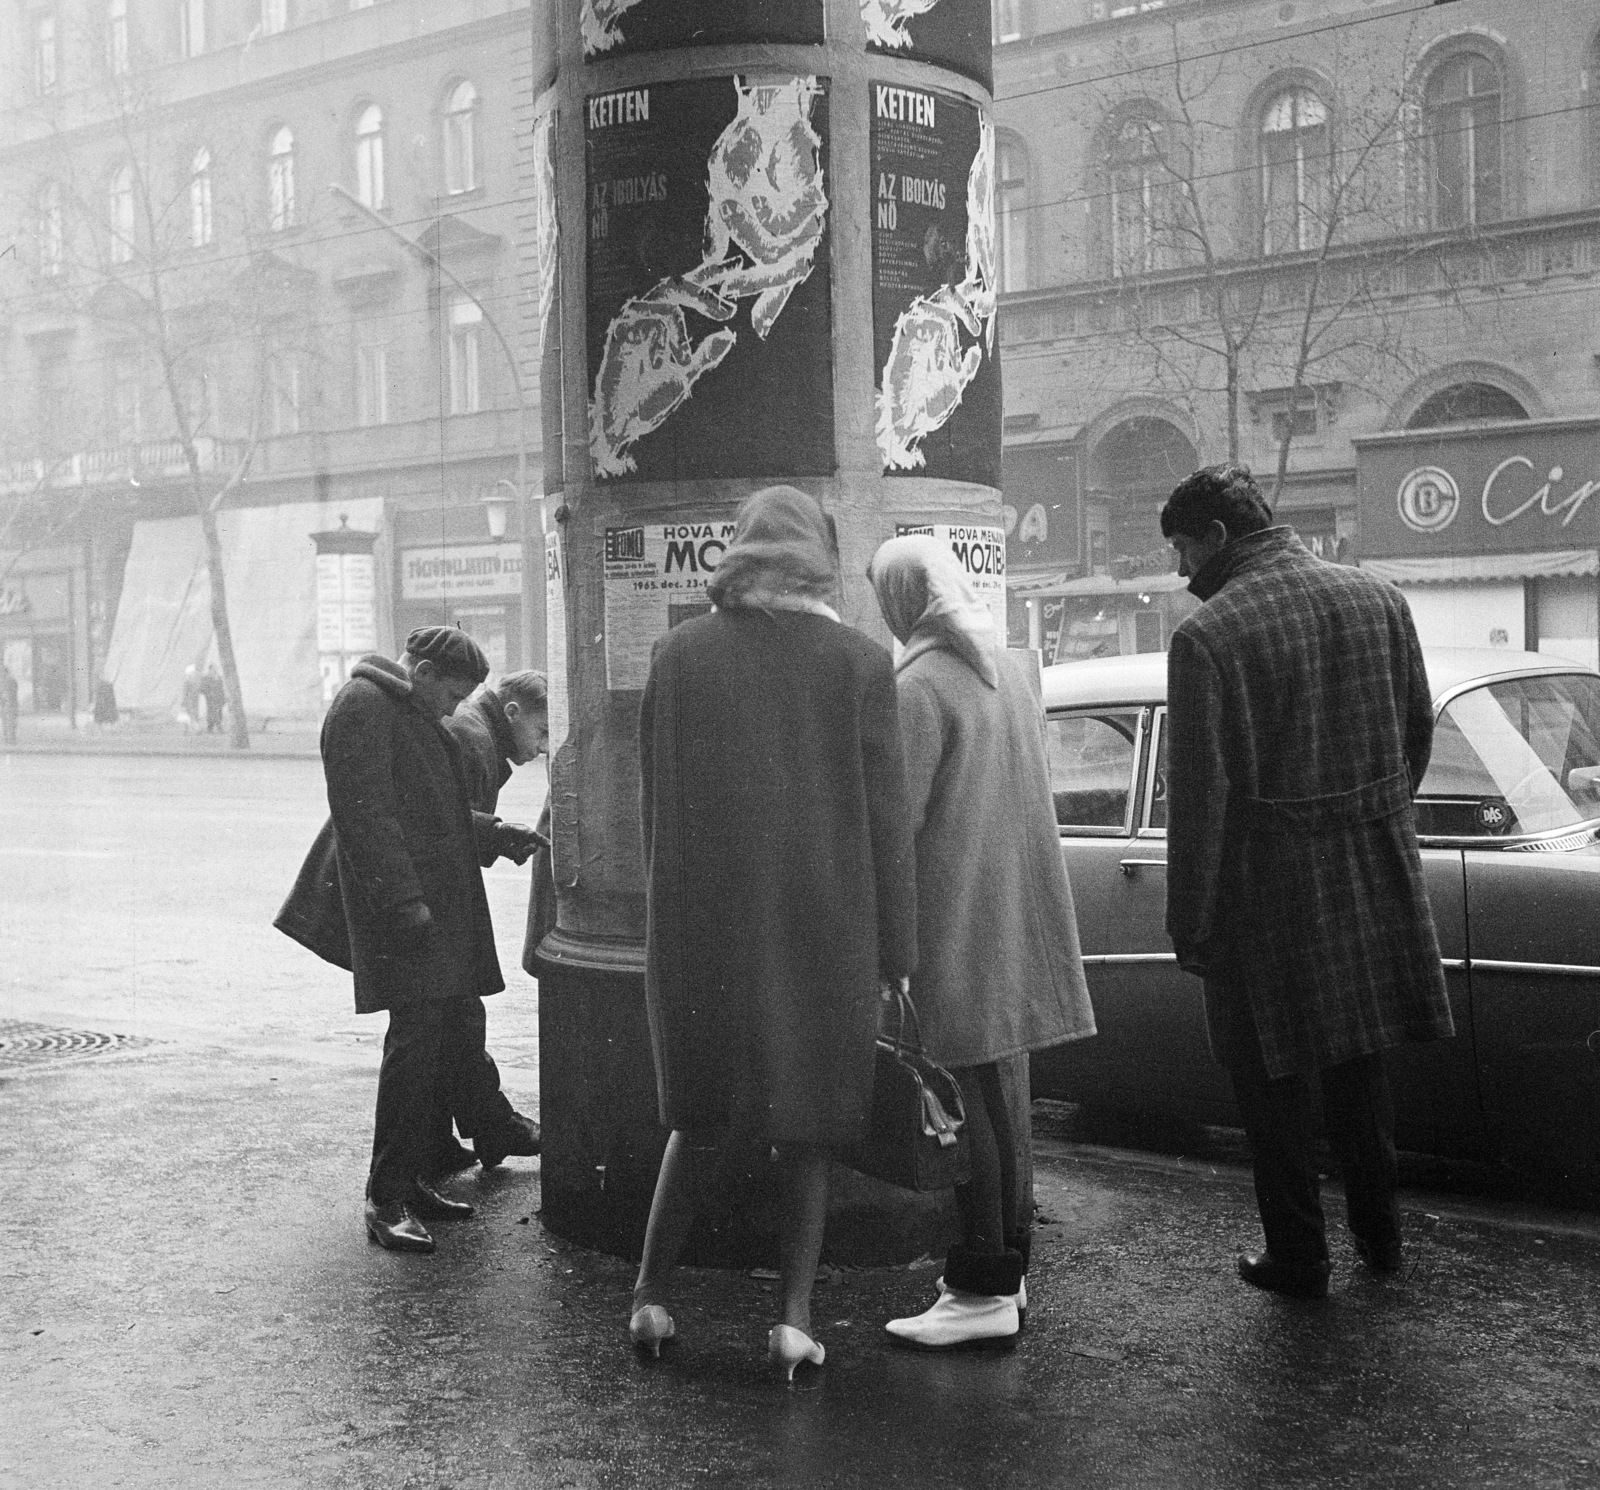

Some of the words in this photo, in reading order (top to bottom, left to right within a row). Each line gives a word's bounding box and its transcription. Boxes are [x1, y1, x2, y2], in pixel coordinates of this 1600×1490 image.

[589, 89, 649, 130] KETTEN
[876, 85, 935, 128] KETTEN
[592, 182, 608, 209] AZ
[613, 171, 667, 205] IBOLYÁS
[878, 172, 897, 200] AZ
[902, 176, 946, 210] IBOLYÁS
[664, 526, 714, 540] HOVA
[949, 527, 978, 541] HOVA
[633, 581, 659, 591] 1965.
[661, 579, 683, 589] dec.
[1483, 807, 1503, 823] DAS
